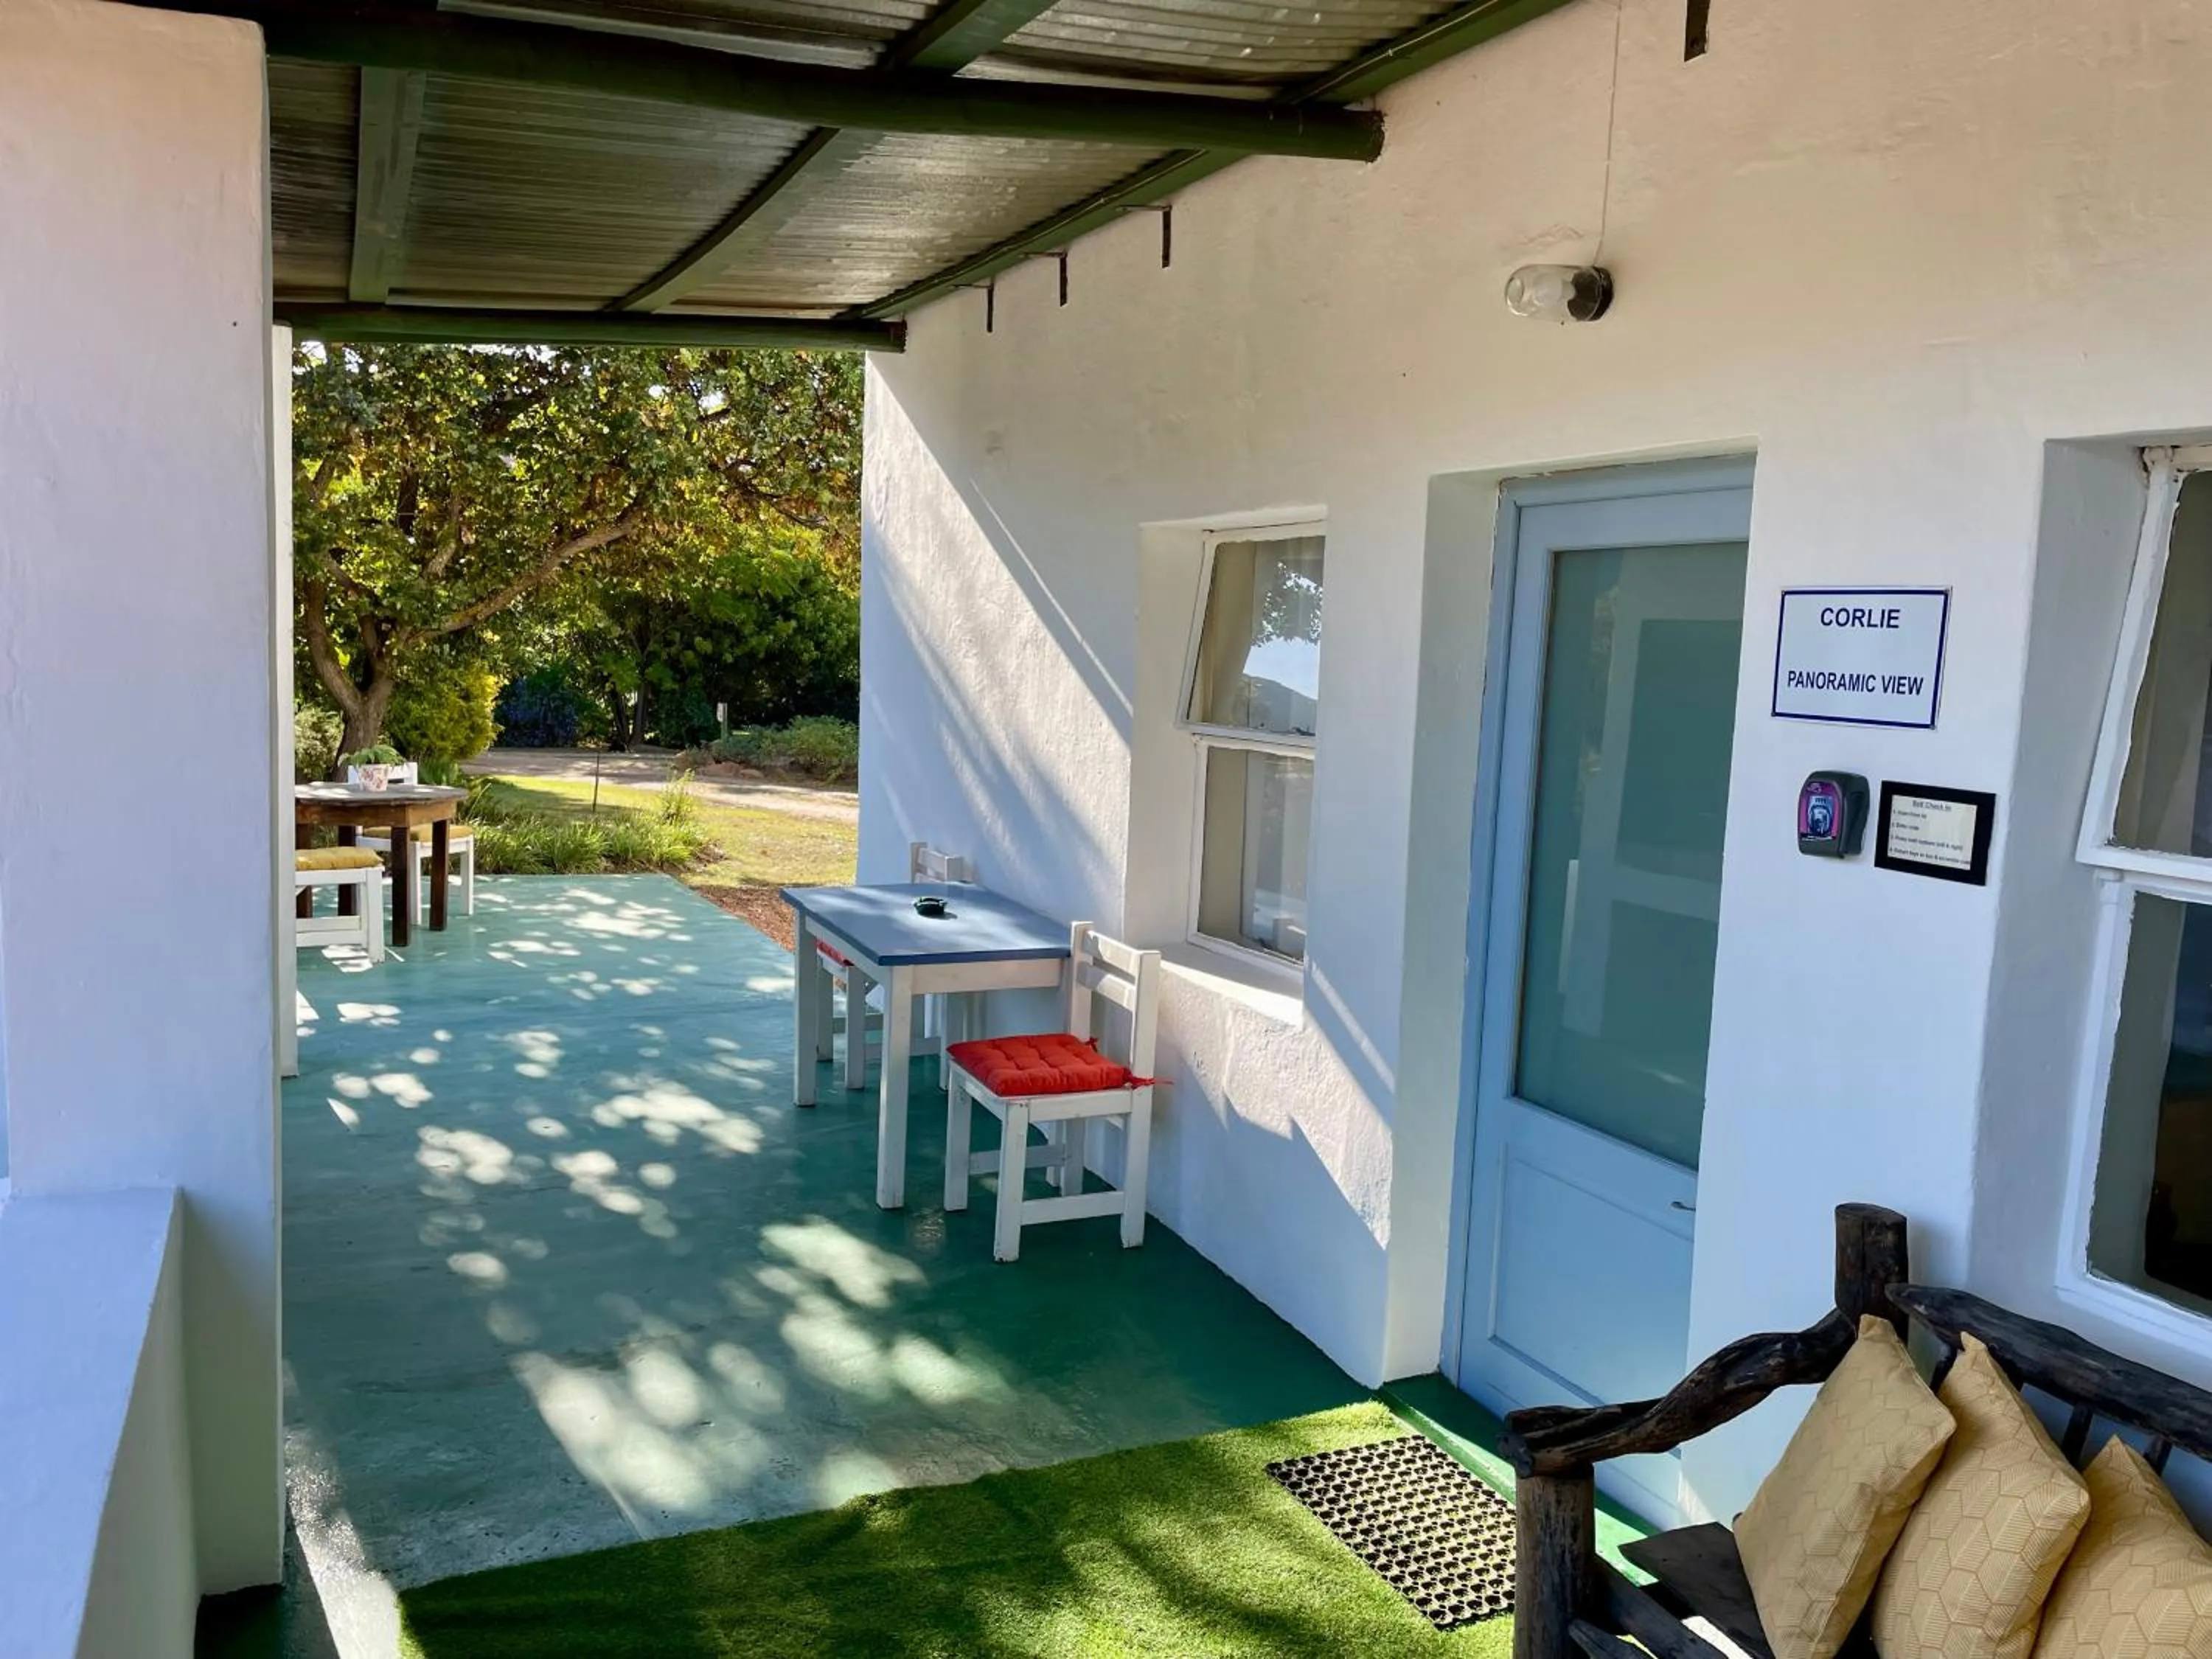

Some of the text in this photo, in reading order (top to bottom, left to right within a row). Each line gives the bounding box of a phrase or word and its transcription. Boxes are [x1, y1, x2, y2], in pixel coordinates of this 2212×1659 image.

[1820, 607, 1901, 629] CORLIE
[1787, 670, 1924, 695] PANORAMIC VIEW
